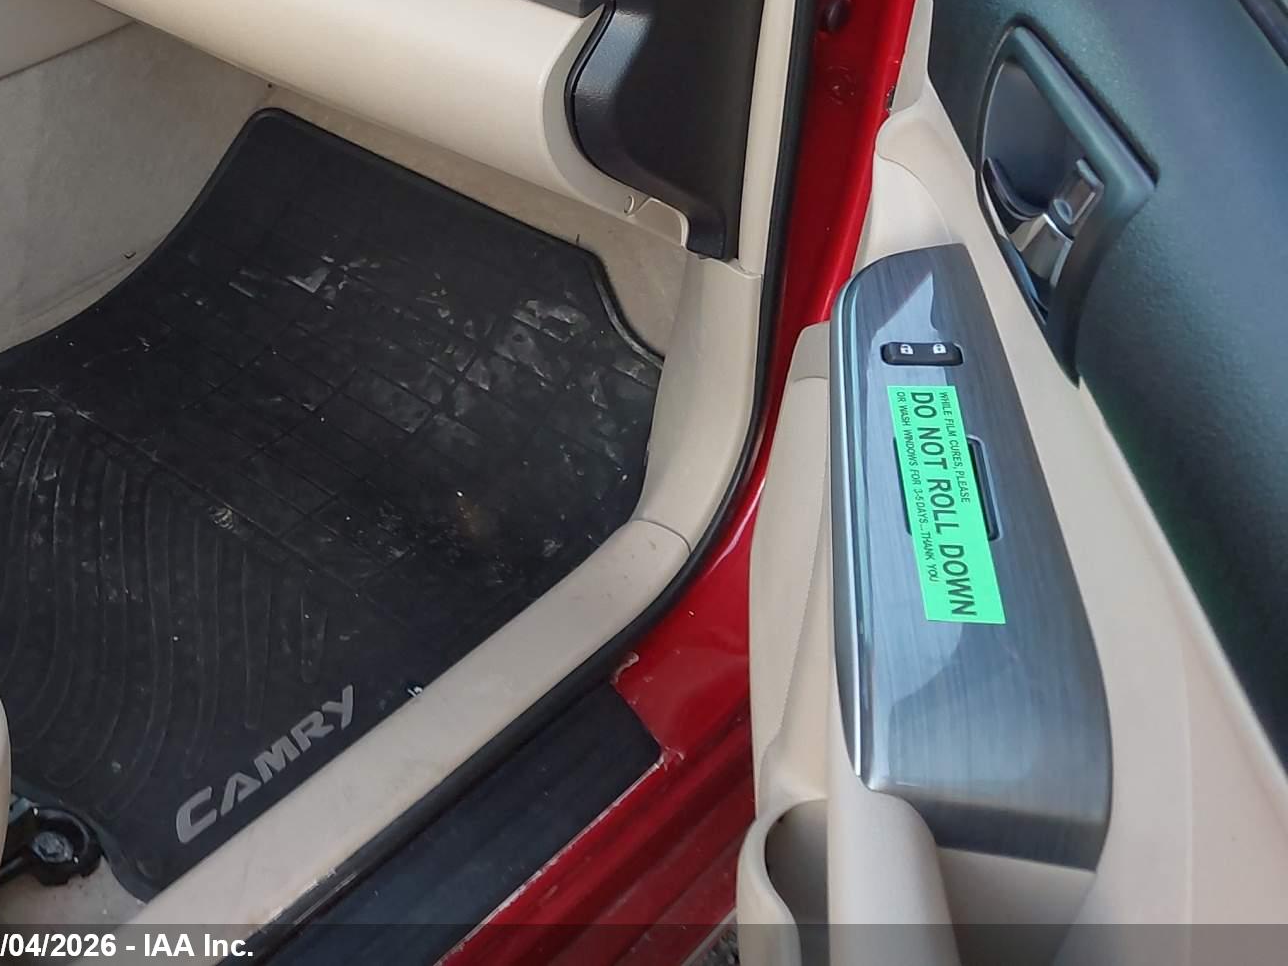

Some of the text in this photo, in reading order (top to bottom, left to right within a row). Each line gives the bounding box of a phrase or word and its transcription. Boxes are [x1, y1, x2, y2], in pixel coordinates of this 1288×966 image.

[896, 391, 907, 403] OR
[898, 404, 911, 427] WASH
[903, 429, 919, 467] WINDOWS
[939, 392, 971, 503] WHILE FILM CURES, PLEASE
[910, 468, 922, 485] FOR
[910, 392, 978, 616] DO NOT ROLL DOWN
[926, 563, 940, 583] YOU
[176, 684, 354, 844] CAMRY
